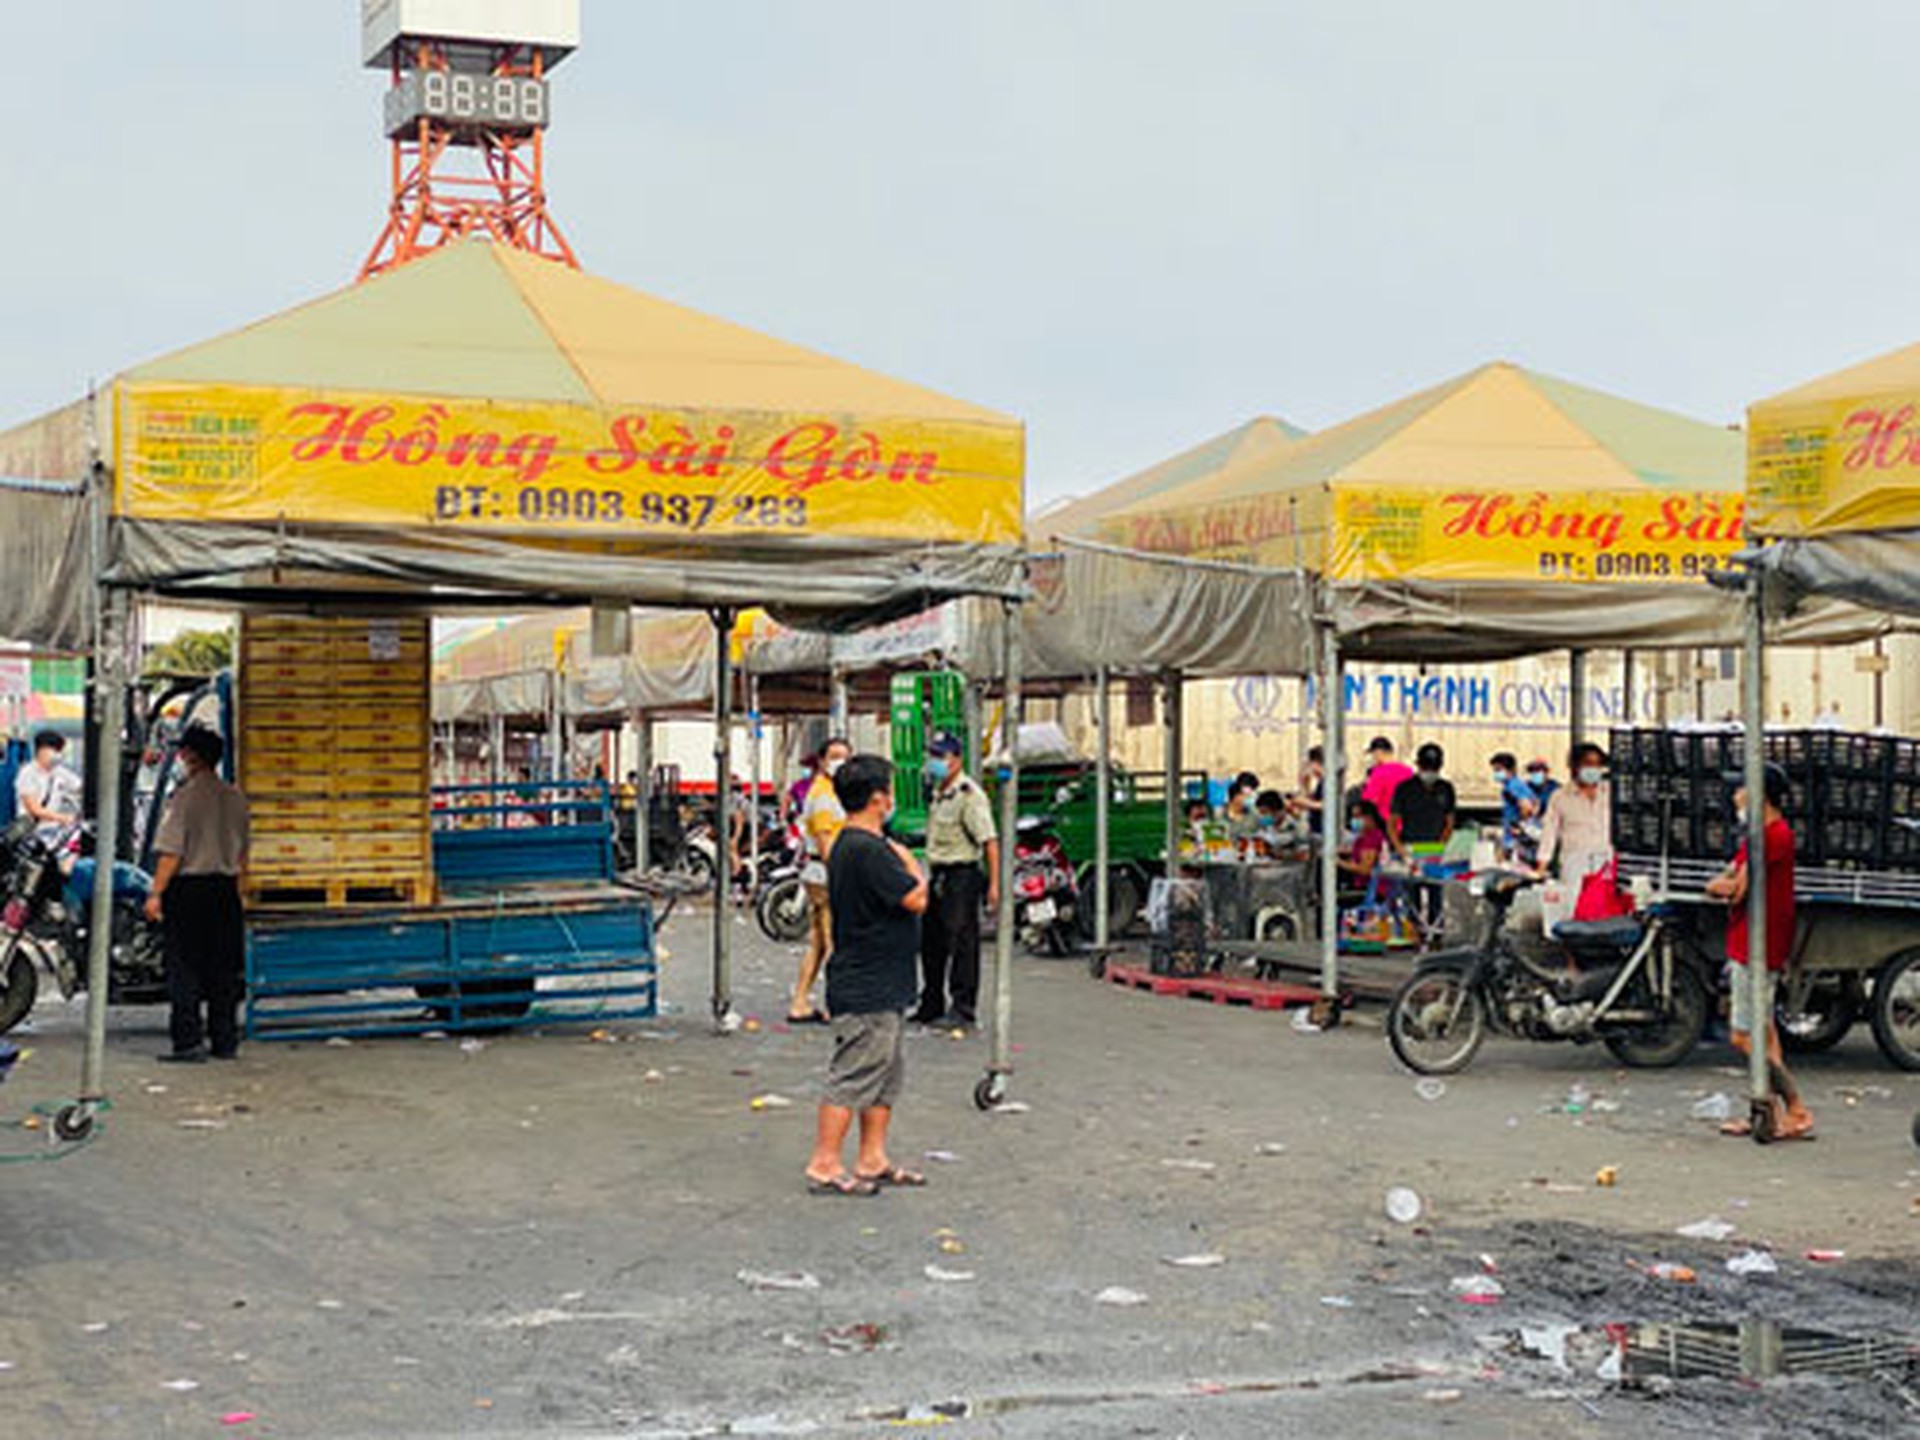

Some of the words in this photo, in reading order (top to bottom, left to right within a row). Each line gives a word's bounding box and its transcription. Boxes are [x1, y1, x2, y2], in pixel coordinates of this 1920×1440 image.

[287, 402, 563, 482] Hồng
[586, 413, 734, 478] Sài
[766, 421, 944, 491] Gòn
[518, 486, 625, 521] 0903
[640, 491, 717, 529] 937
[1440, 491, 1625, 549] Hồng
[1643, 496, 1745, 542] Sài
[1595, 552, 1671, 577] 0903
